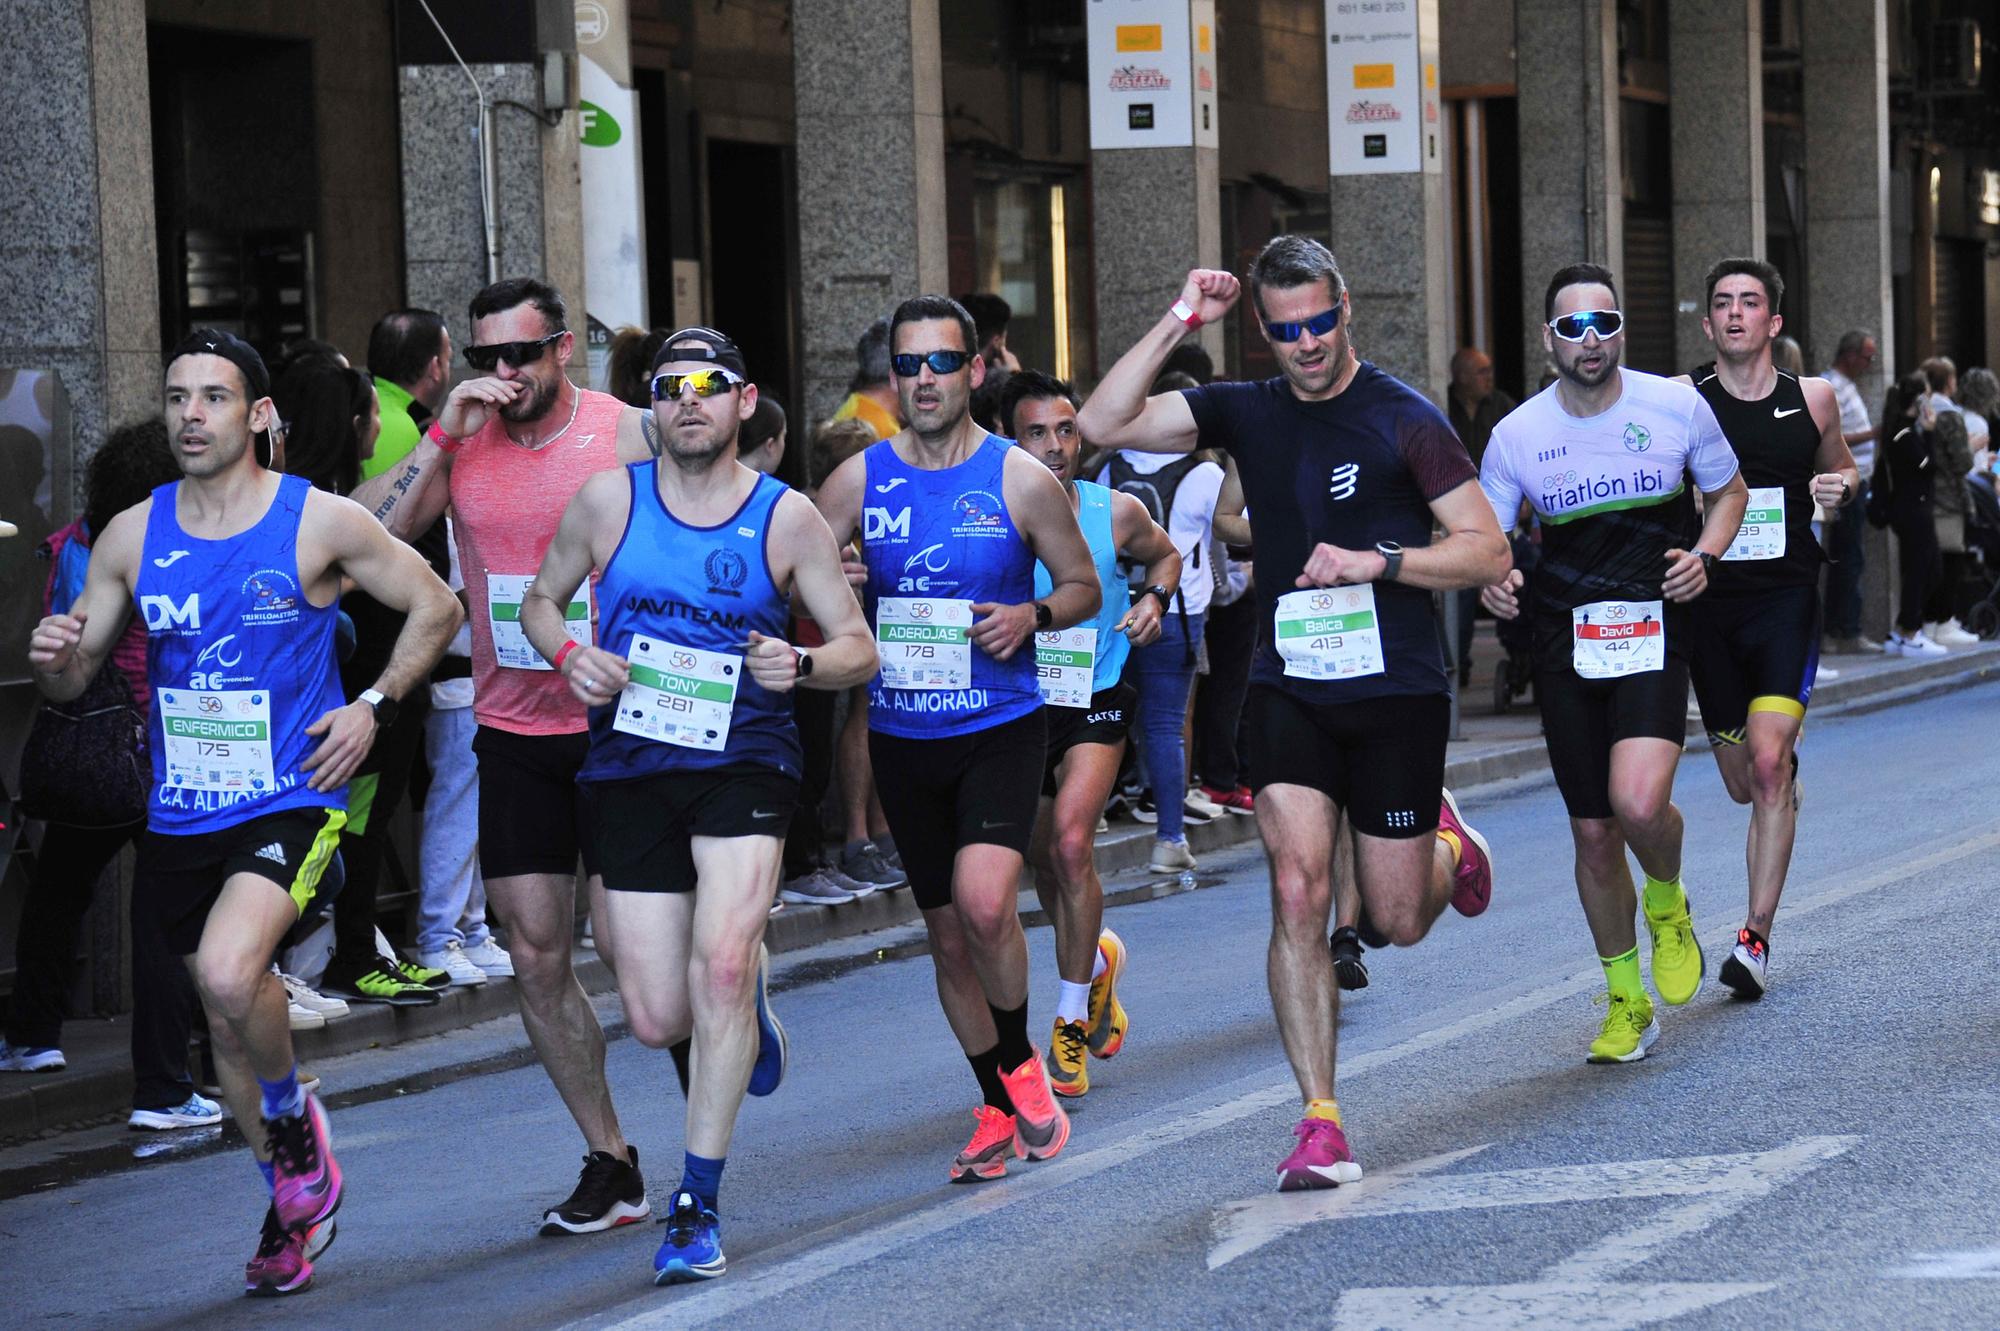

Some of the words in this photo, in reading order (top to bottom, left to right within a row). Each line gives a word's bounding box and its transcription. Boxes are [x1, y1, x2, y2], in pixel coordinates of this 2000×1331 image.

[1542, 474, 1626, 512] triatlón
[1633, 469, 1663, 493] ibi
[864, 507, 911, 540] DM
[140, 593, 201, 631] DM
[626, 596, 745, 630] JAVITEAM
[888, 627, 958, 641] ADEROJAS
[1305, 618, 1343, 633] Balca
[1600, 624, 1634, 637] David
[905, 645, 935, 658] 178
[1310, 636, 1343, 650] 413
[1605, 641, 1631, 652] 44
[658, 673, 701, 694] TONY
[657, 694, 694, 714] 281
[894, 689, 988, 712] ALMORADI
[1087, 710, 1122, 724] SATSE
[173, 720, 257, 737] ENFERMICO
[197, 741, 230, 757] 175
[159, 783, 188, 810] C.A.
